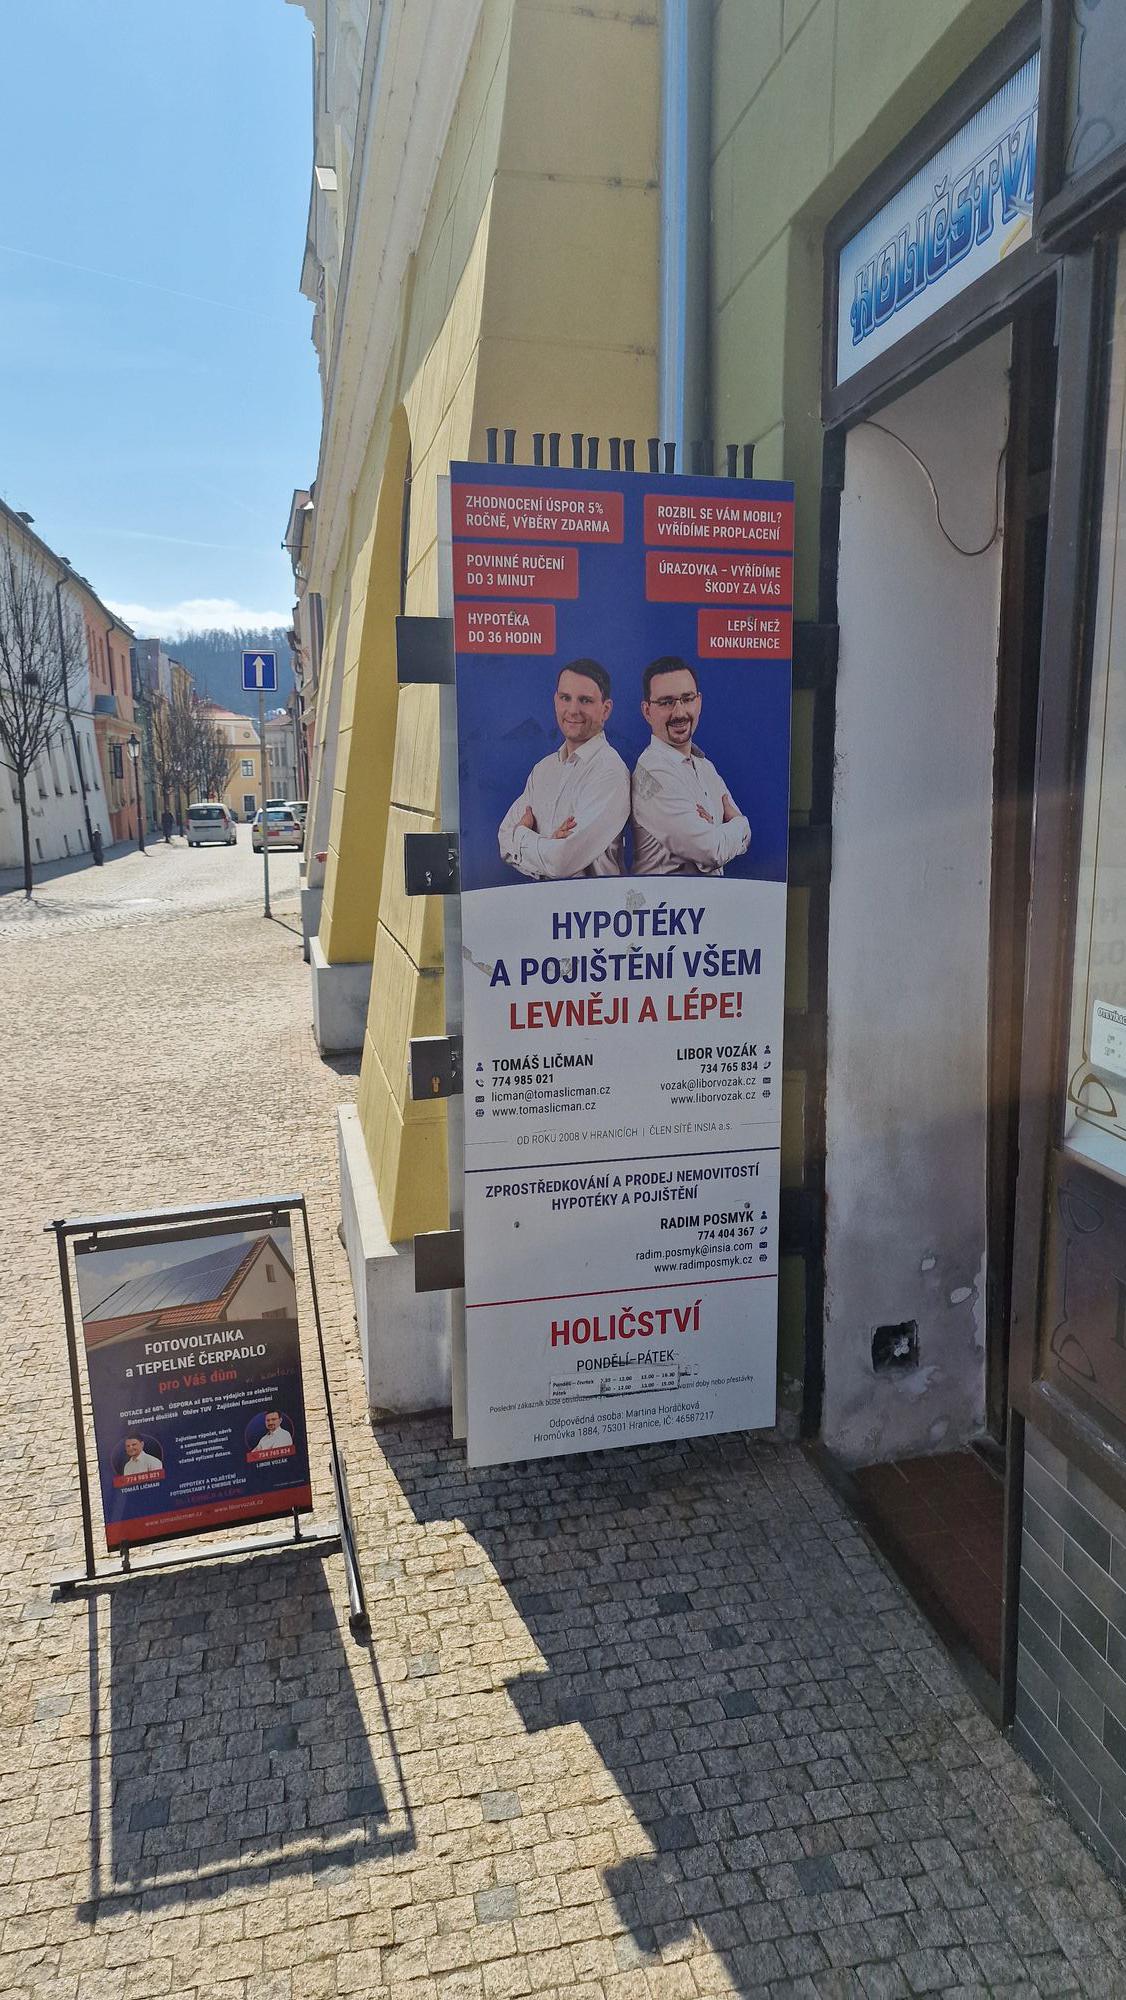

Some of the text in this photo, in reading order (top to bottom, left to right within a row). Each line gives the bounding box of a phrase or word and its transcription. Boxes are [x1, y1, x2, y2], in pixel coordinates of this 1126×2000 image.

[466, 494, 604, 514] ZHODNOCENÍ ÚSPOR 5%
[658, 504, 782, 523] ROZBIL SE VÁM MOBIL?
[466, 511, 610, 532] ROČNĚ, VÝBĚRY ZDARMA
[658, 520, 780, 540] VYŘÍDÍME PROPLACENÍ
[466, 553, 564, 570] POVINNÉ RUČENÍ
[659, 560, 718, 576] ÚRAZOVKA
[730, 561, 780, 578] VYŘÍDÍME
[467, 572, 536, 587] DO 3 MINUT
[705, 579, 780, 596] ŠKODY ZA VÁS
[468, 610, 530, 626] HYPOTÉKA
[728, 616, 780, 632] LEPŠÍ NEŽ
[468, 630, 542, 645] DO 36 HODIN
[710, 636, 780, 649] KONKURENCE
[552, 902, 705, 940] HYPOTÉKY
[490, 944, 761, 987] A POJIŠTĚNÍ VŠEM
[510, 988, 743, 1030] LEVNĚJI A LÉPE!
[677, 1042, 757, 1060] LIBOR VOZÁK
[492, 1053, 593, 1072] TOMÁŠ LIČMAN
[700, 1061, 758, 1074] 734 765 834
[492, 1074, 554, 1087] 774 985 021
[660, 1076, 756, 1092] vozak@liborvozak.cz
[492, 1086, 610, 1102] licman@tomaslicman.cz
[671, 1090, 756, 1104] www.liborvozak.cz
[492, 1102, 596, 1116] www.tomaslicman.cz
[517, 1136, 529, 1145] OD
[532, 1133, 556, 1144] ROKU
[559, 1132, 579, 1142] 2008
[582, 1131, 588, 1140] V
[590, 1126, 638, 1139] HRANICÍCH
[650, 1123, 672, 1136] ČLEN
[674, 1122, 692, 1134] SÍTĚ
[694, 1122, 716, 1132] INSIA
[486, 1162, 760, 1198] ZPROSTŘEDKOVÁNÍ A PRODEJ NEMOVITOSTÍ
[552, 1184, 698, 1210] HYPOTÉKY A POJIŠTĚNÍ
[660, 1211, 754, 1230] RADIM POSMYK
[698, 1226, 754, 1240] 774 404 367
[636, 1242, 752, 1261] radim.posmyk@insia.com
[654, 1255, 752, 1272] www.radimposmyk.cz
[551, 1299, 702, 1347] HOLIČSTVÍ
[145, 1329, 244, 1355] FOTOVOLTAIKA
[126, 1344, 266, 1378] a TEPELNÉ ČERPADLO
[159, 1368, 237, 1393] pro Váš dům
[120, 1408, 142, 1418] DOTACE
[550, 1400, 700, 1428] Odpovědná osoba: Martina Horáčková
[534, 1411, 714, 1442] Hromůvka 1884, 75301 Hranice, IČ: 46587217
